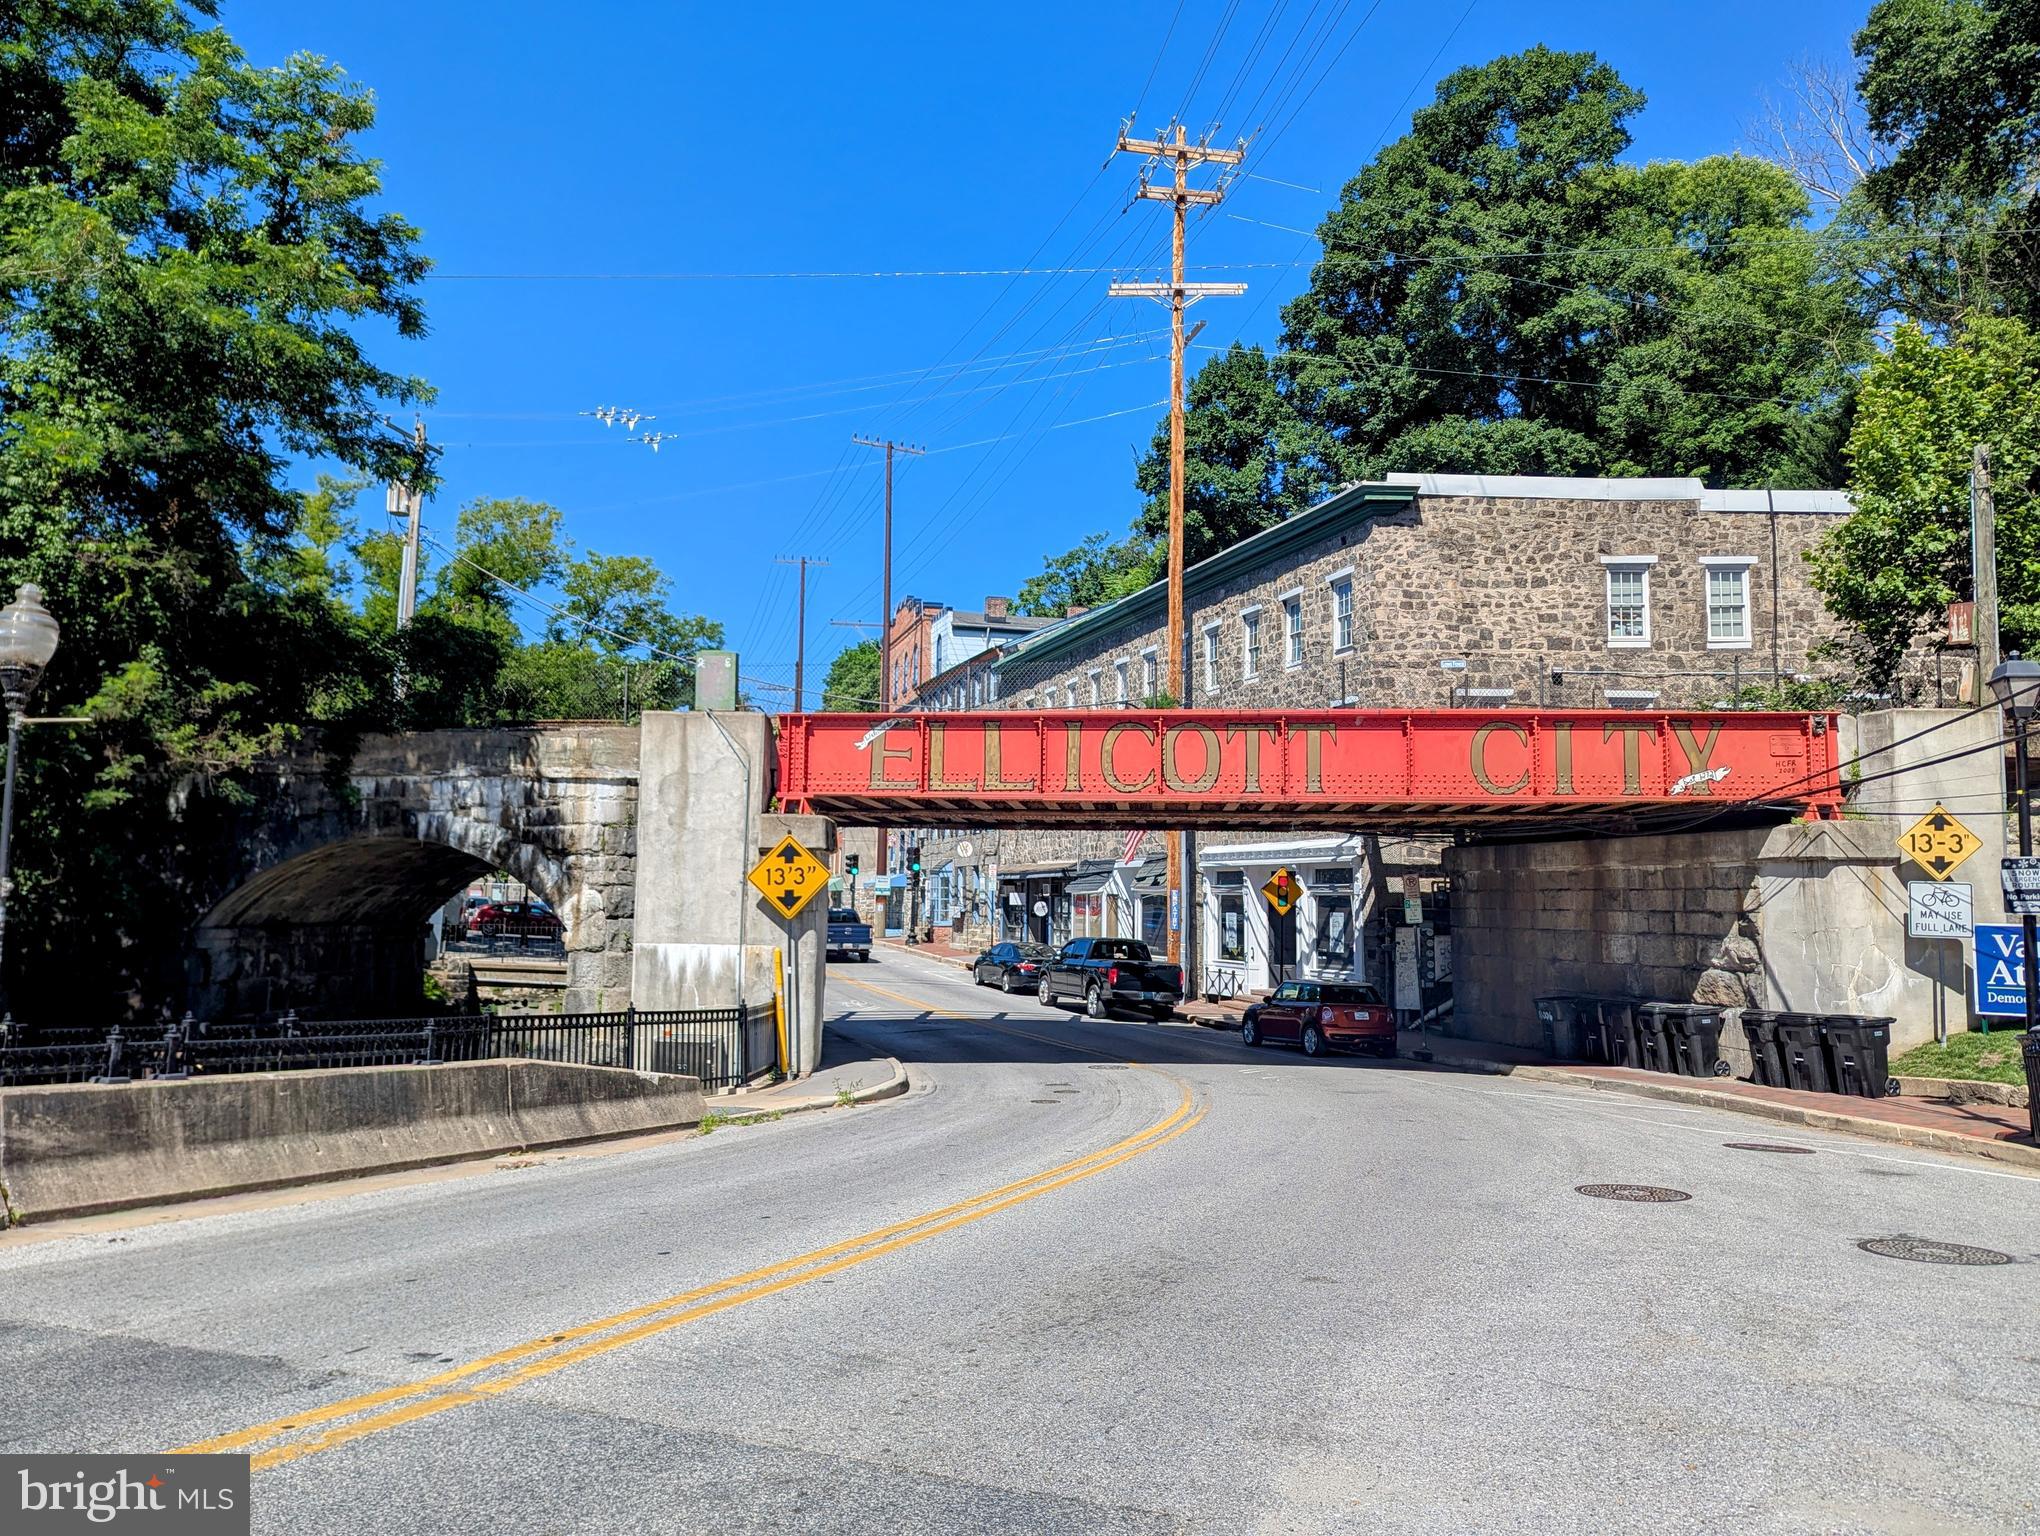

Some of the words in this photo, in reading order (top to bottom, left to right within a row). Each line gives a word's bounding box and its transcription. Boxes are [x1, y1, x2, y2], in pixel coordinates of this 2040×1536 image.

[867, 720, 1337, 793] ELLICOTT
[1470, 720, 1726, 795] CITY
[1910, 833, 1969, 854] 13'-3"
[766, 866, 816, 886] 13'3"
[1920, 910, 1940, 919] MAY
[1944, 911, 1963, 920] USE
[1915, 922, 1938, 932] FULL
[1943, 923, 1968, 933] LANE
[1987, 992, 2027, 1004] Demo
